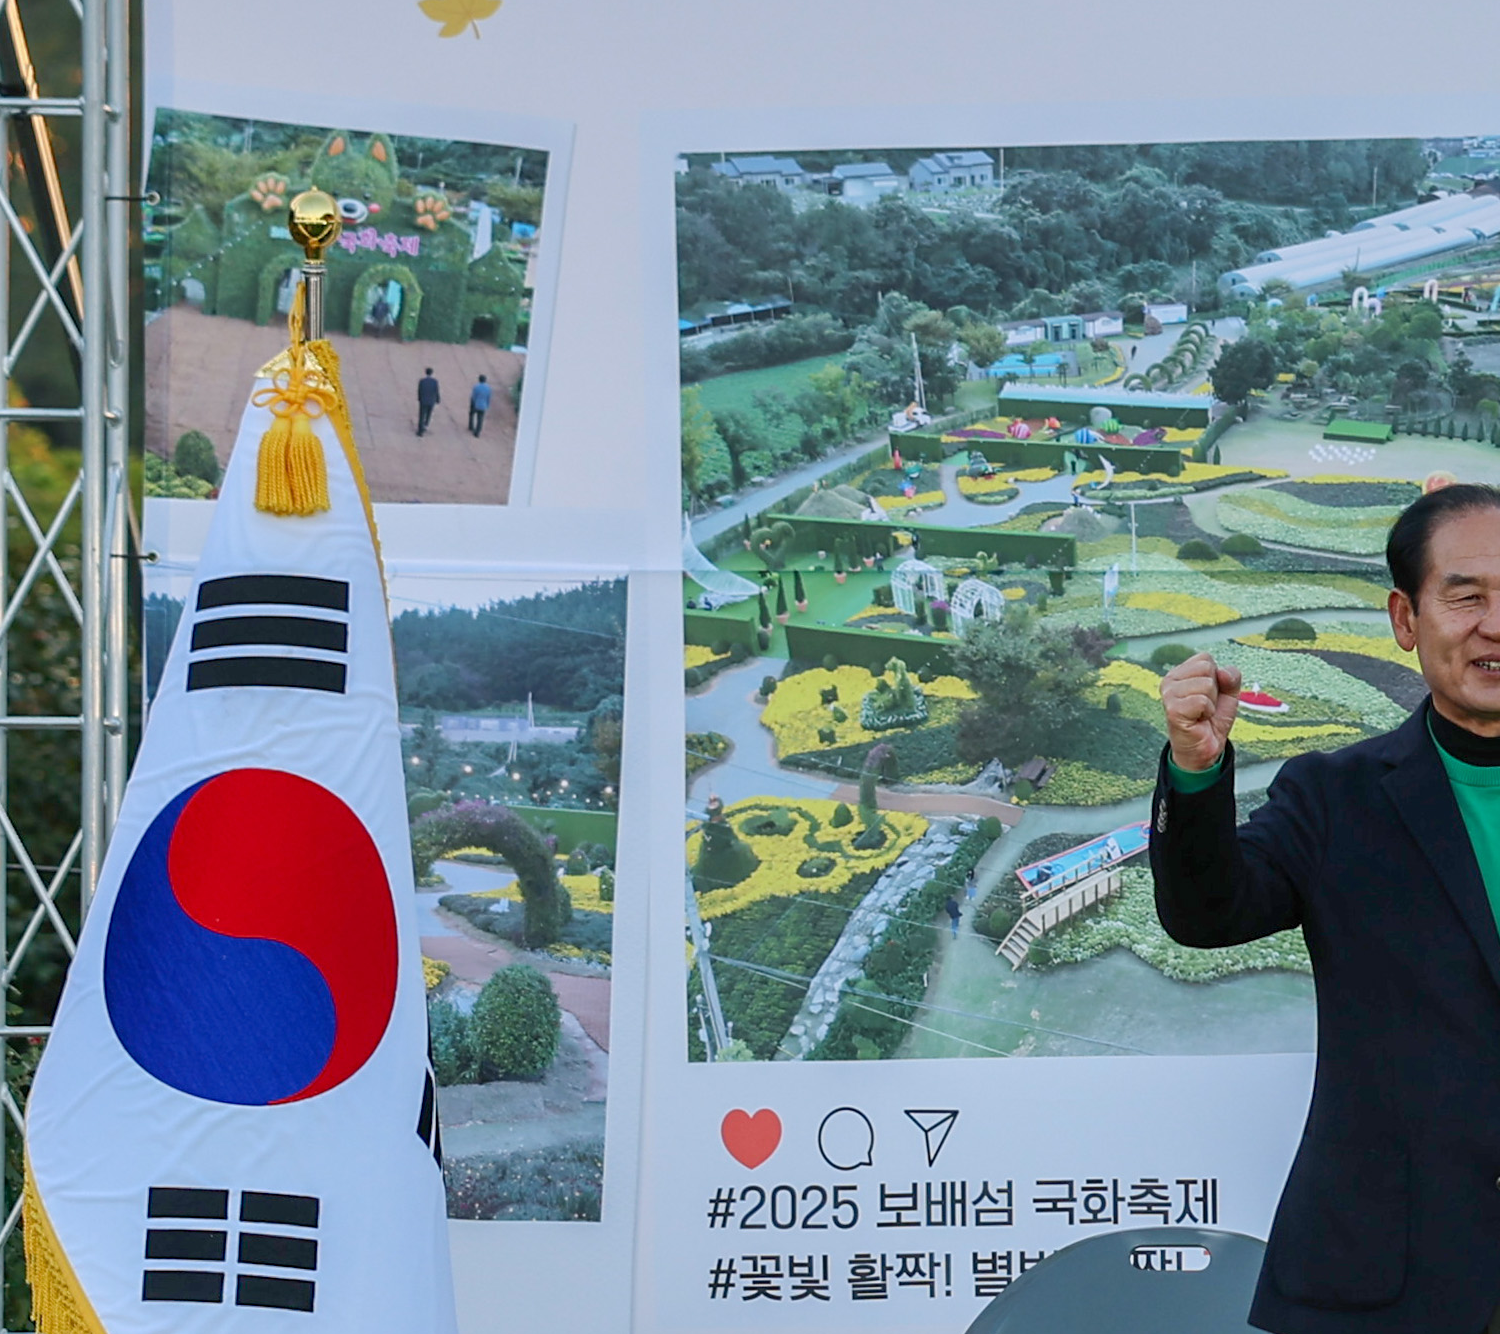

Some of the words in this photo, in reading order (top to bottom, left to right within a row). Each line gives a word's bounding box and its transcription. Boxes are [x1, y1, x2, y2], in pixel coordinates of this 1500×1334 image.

[706, 1184, 859, 1230] #2025
[876, 1179, 1014, 1228] 보배섬
[1032, 1177, 1218, 1226] 국화축제
[707, 1254, 831, 1302] #꽃빛
[847, 1251, 952, 1301] 활짝!
[972, 1250, 1056, 1297] 별
